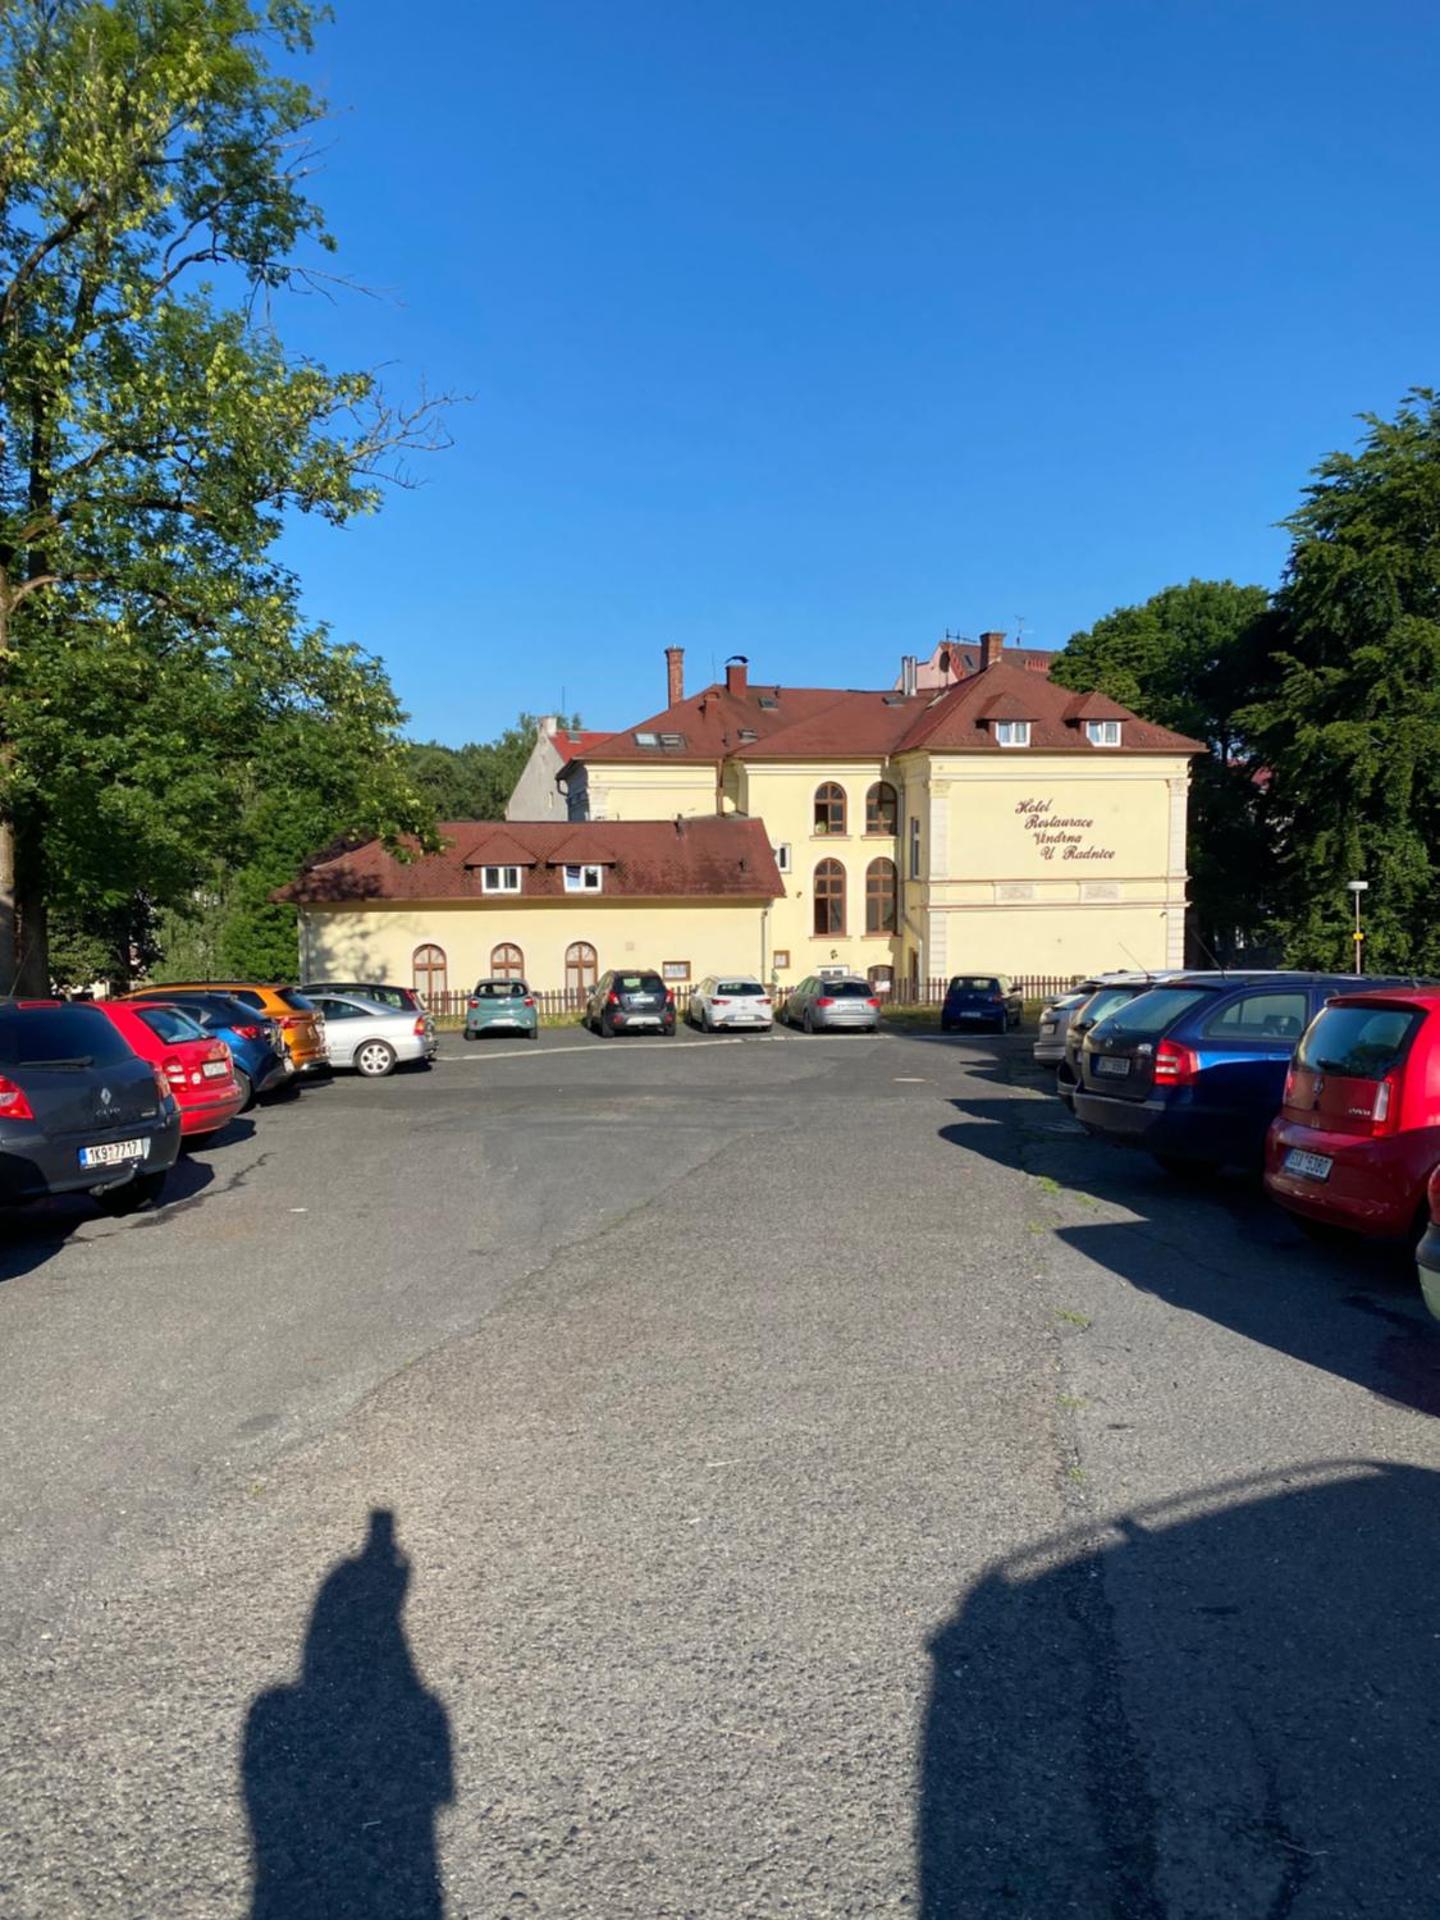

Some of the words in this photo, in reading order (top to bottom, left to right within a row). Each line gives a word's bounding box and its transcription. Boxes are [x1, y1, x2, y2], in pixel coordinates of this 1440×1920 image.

[1015, 799, 1052, 814] Hotel
[1024, 814, 1093, 830] Restaurace
[1040, 846, 1056, 860] U
[1062, 845, 1116, 860] Radnice
[89, 1147, 108, 1162] 1K9
